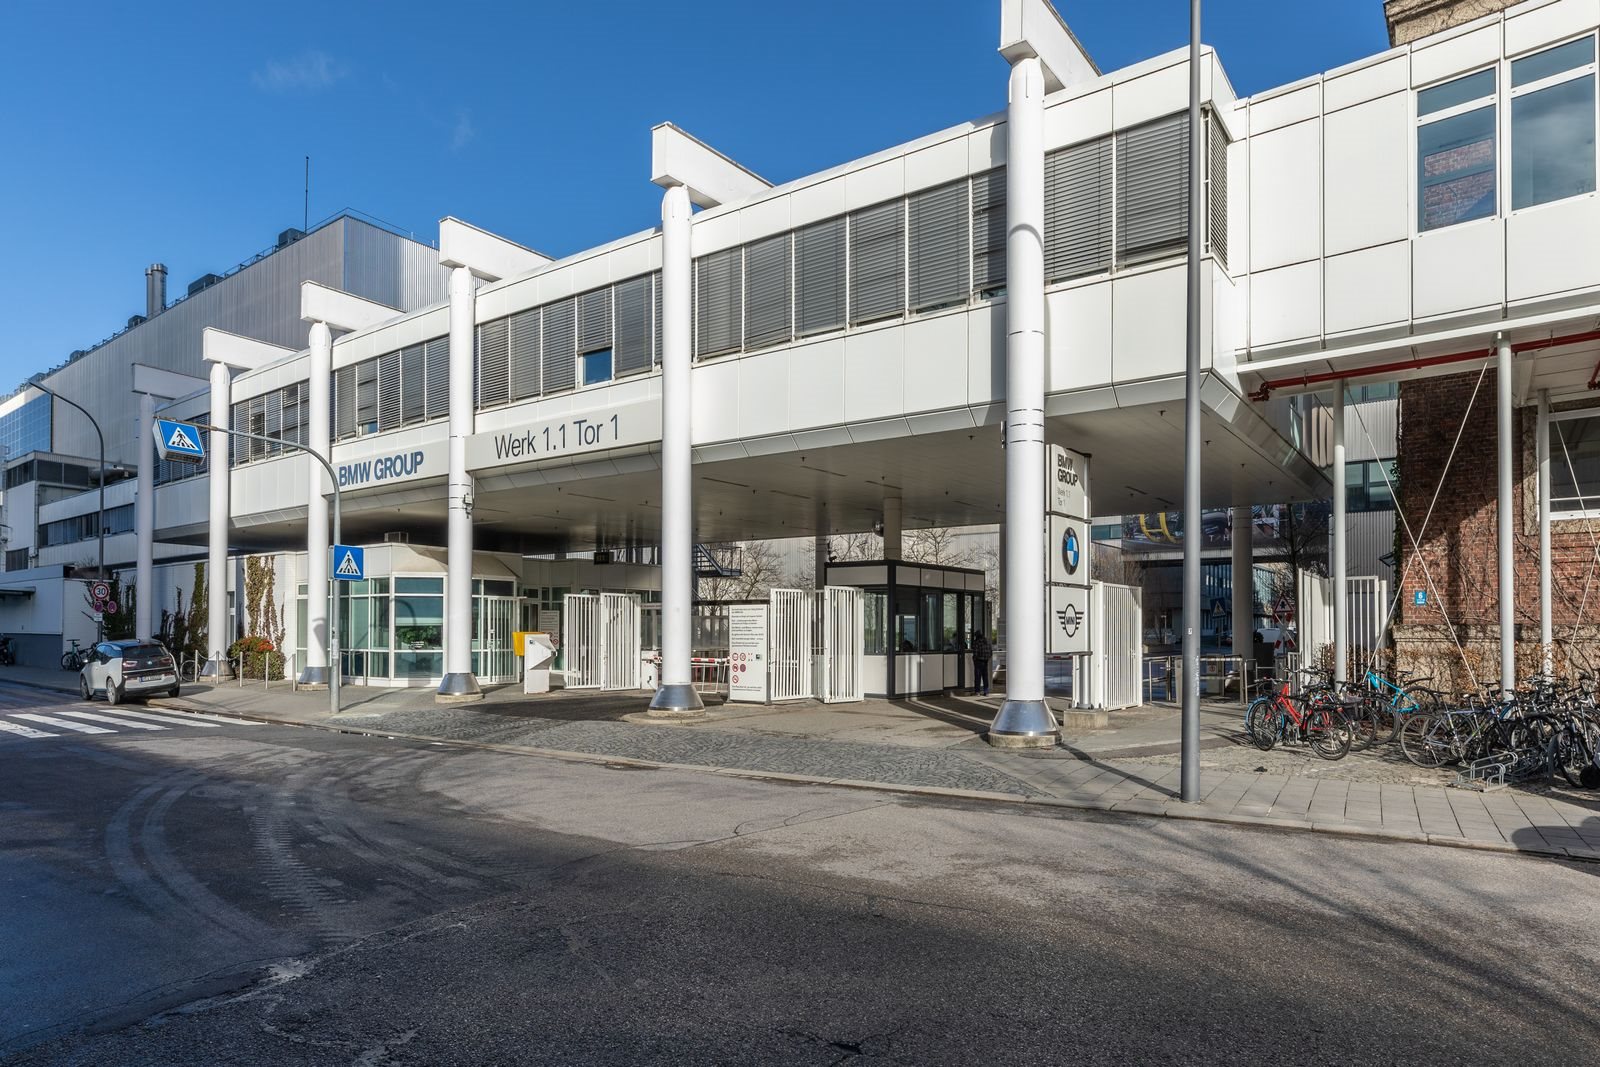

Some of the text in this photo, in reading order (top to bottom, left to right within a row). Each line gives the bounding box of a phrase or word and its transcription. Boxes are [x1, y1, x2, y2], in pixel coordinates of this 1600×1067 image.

[495, 414, 618, 459] Werk 1.1 Tor 1
[339, 451, 424, 486] BMW GROUP
[1057, 454, 1073, 471] BMW
[1057, 469, 1079, 486] GROUP
